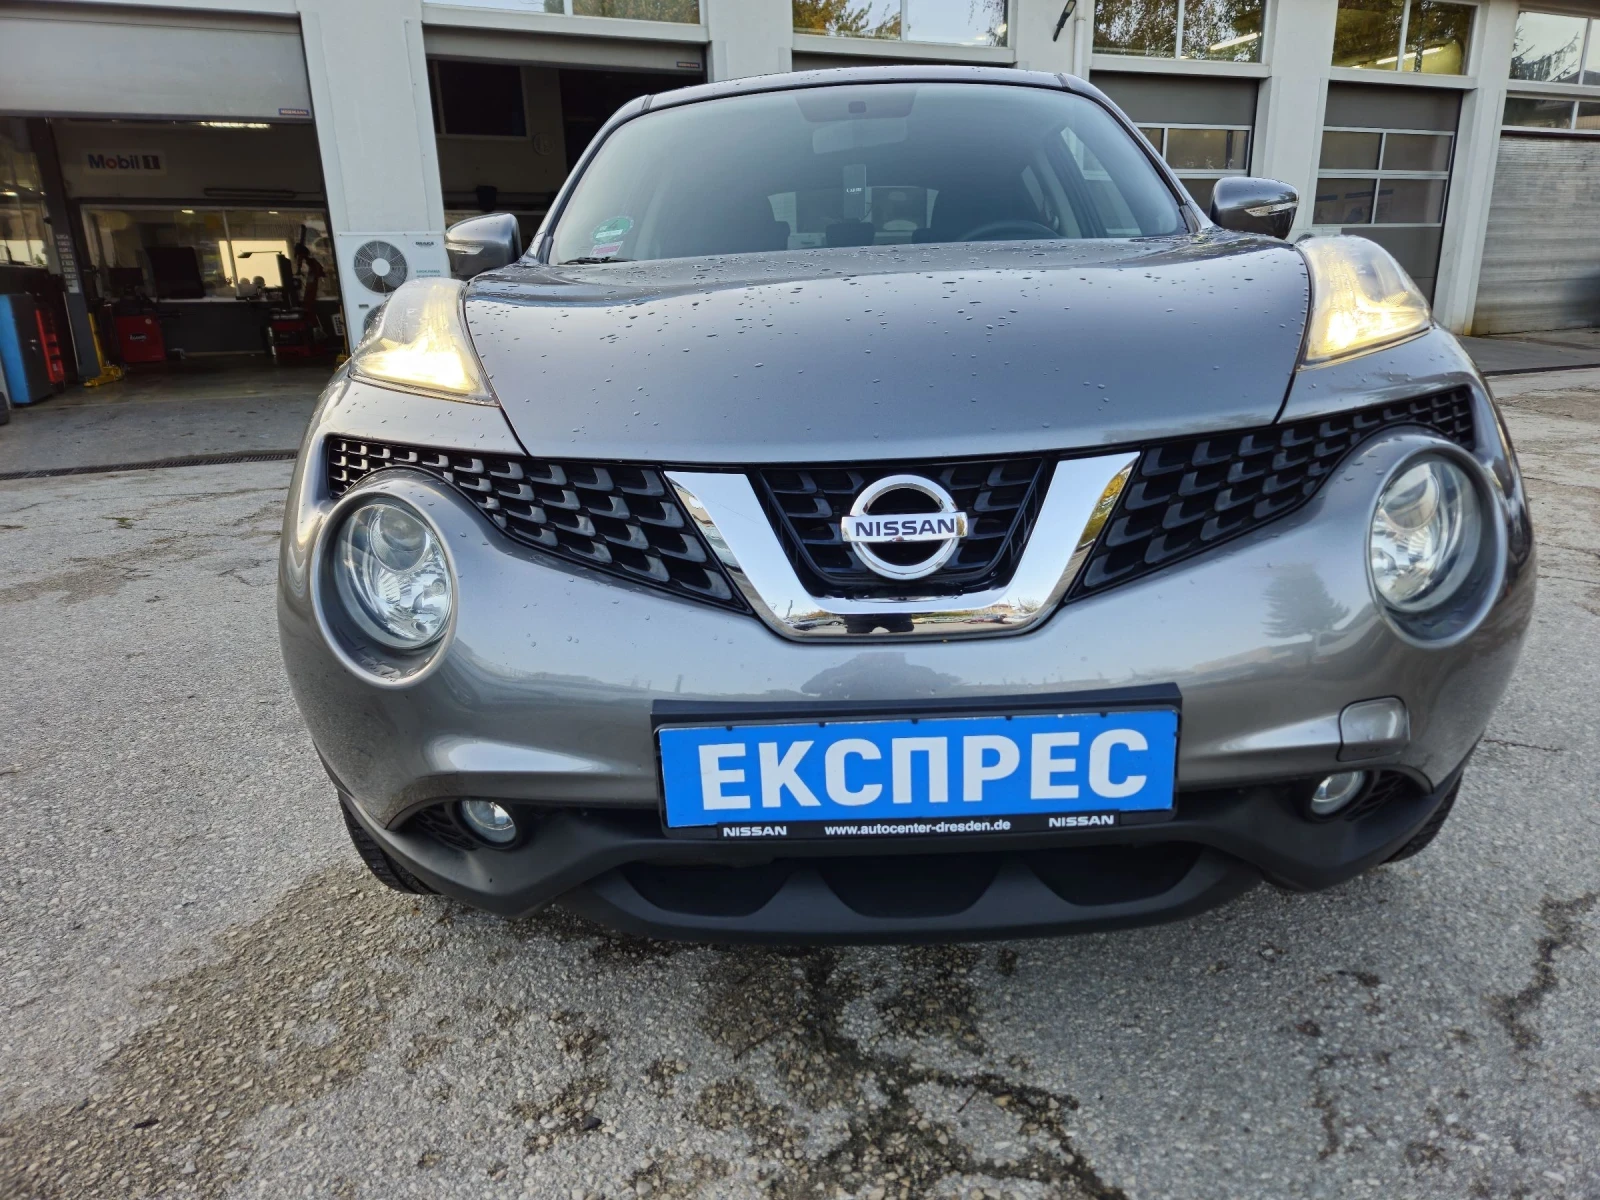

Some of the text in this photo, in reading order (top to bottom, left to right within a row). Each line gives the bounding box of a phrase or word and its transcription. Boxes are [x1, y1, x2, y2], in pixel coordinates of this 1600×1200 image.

[87, 153, 141, 170] Mobil
[855, 518, 955, 537] NISSAN
[698, 728, 1149, 811] ЕКСПРЕС
[723, 815, 1115, 837] NISSAN www.autocenter-dresden.de NISSAN
